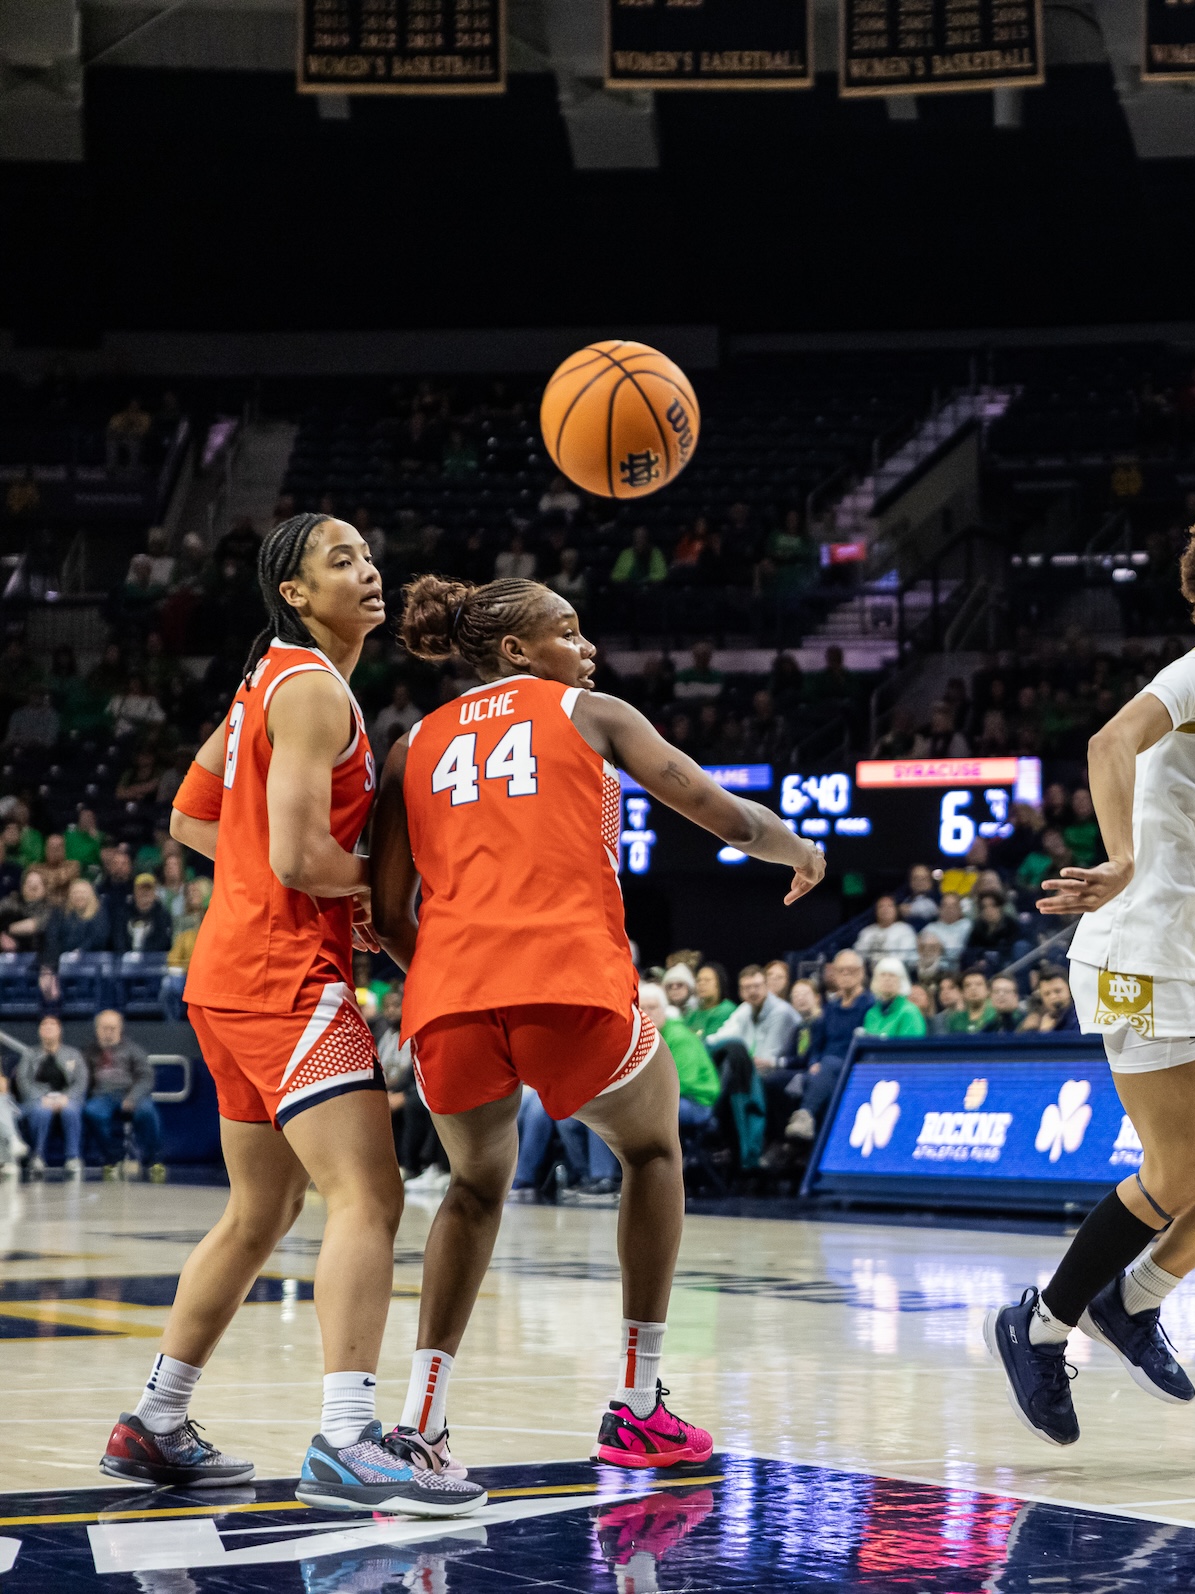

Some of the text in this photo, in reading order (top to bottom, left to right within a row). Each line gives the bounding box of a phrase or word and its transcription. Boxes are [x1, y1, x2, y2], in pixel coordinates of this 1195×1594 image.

[307, 54, 495, 78] WOMEN'S BASKETBALL
[613, 50, 804, 71] WOMEN'S BASKETBALL
[848, 47, 1034, 78] WOMEN'S BASKETBALL
[459, 689, 519, 725] UCHE
[432, 719, 538, 807] 44
[893, 763, 982, 779] SYRACUSE
[781, 773, 850, 814] 6:40
[938, 790, 976, 856] 6
[915, 1112, 1013, 1147] ROCKNE
[911, 1145, 1001, 1163] ATHLETICS FUND
